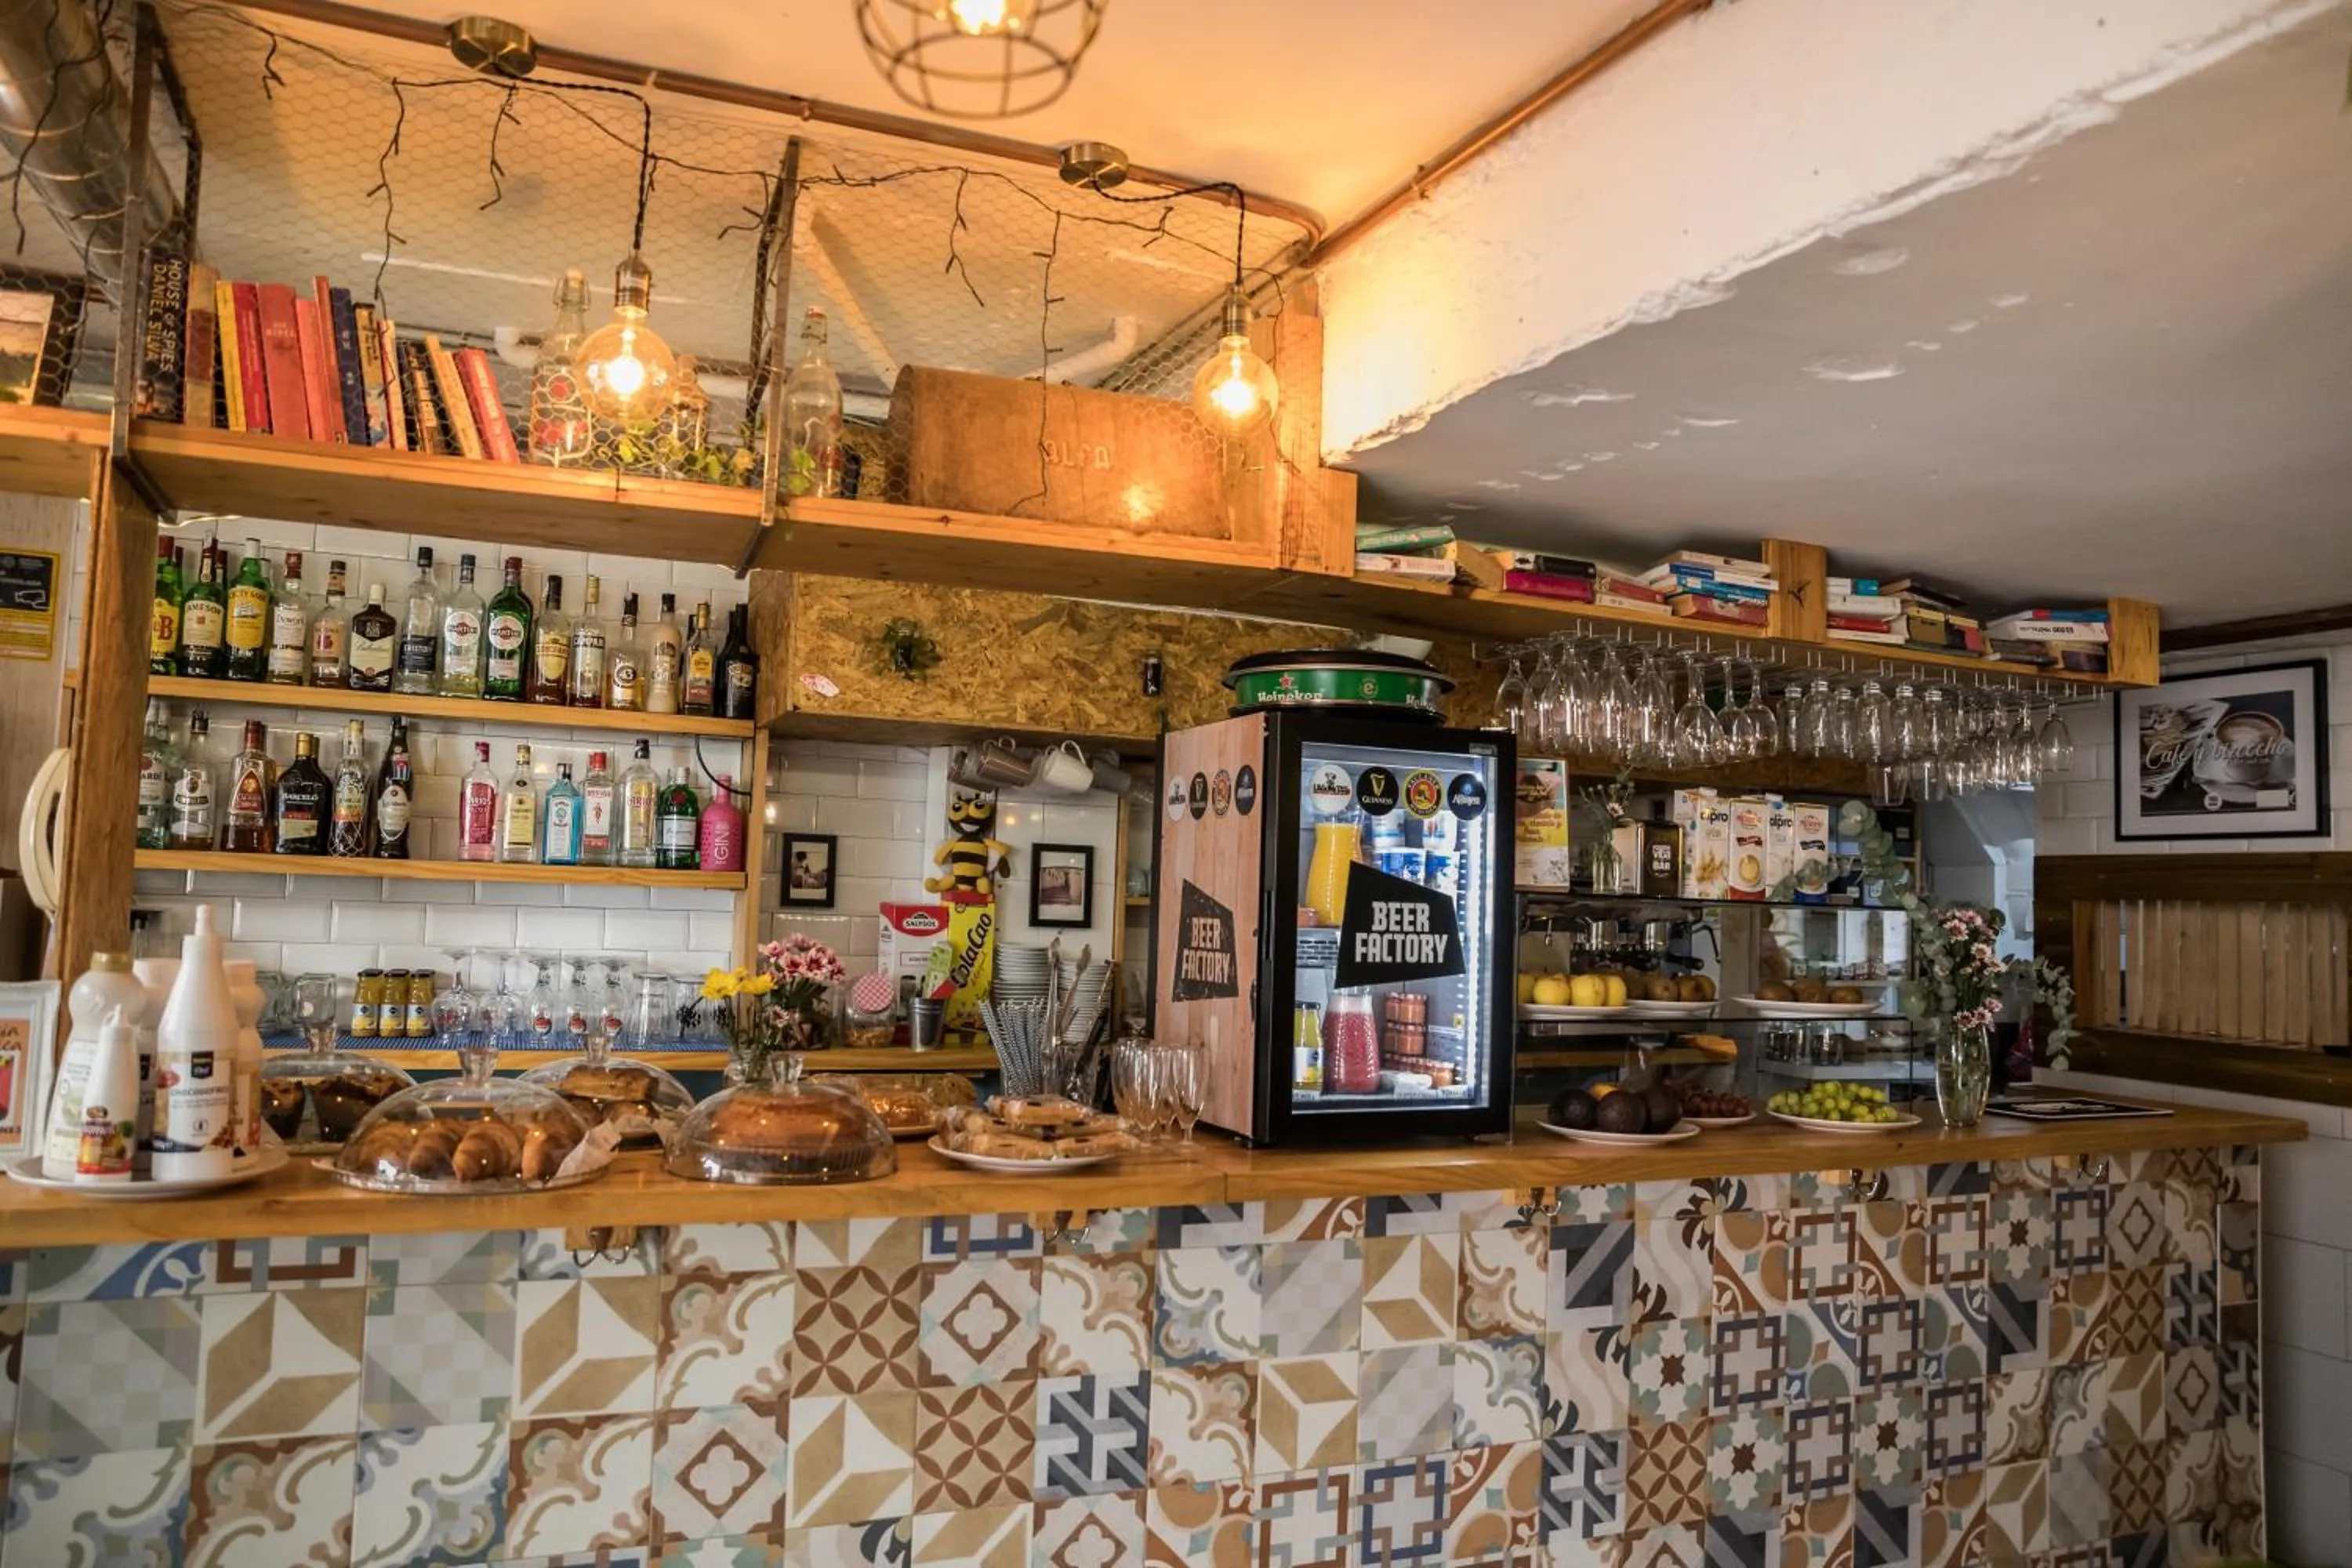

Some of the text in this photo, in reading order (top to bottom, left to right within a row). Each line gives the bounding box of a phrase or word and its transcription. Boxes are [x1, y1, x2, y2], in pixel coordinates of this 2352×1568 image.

[149, 263, 167, 315] DANIEL
[165, 260, 183, 310] HOUSE
[160, 328, 176, 372] SPIES
[1257, 689, 1323, 702] Heineken
[142, 770, 163, 780] ARDÍ
[1362, 795, 1393, 804] GUINNESS
[1700, 807, 1729, 825] alpro
[1769, 812, 1793, 830] alpro
[1371, 900, 1430, 932] BEER
[1190, 916, 1221, 949] BEER
[1354, 933, 1449, 964] FACTORY
[949, 913, 992, 989] ColaCao
[1181, 949, 1231, 984] FACTORY
